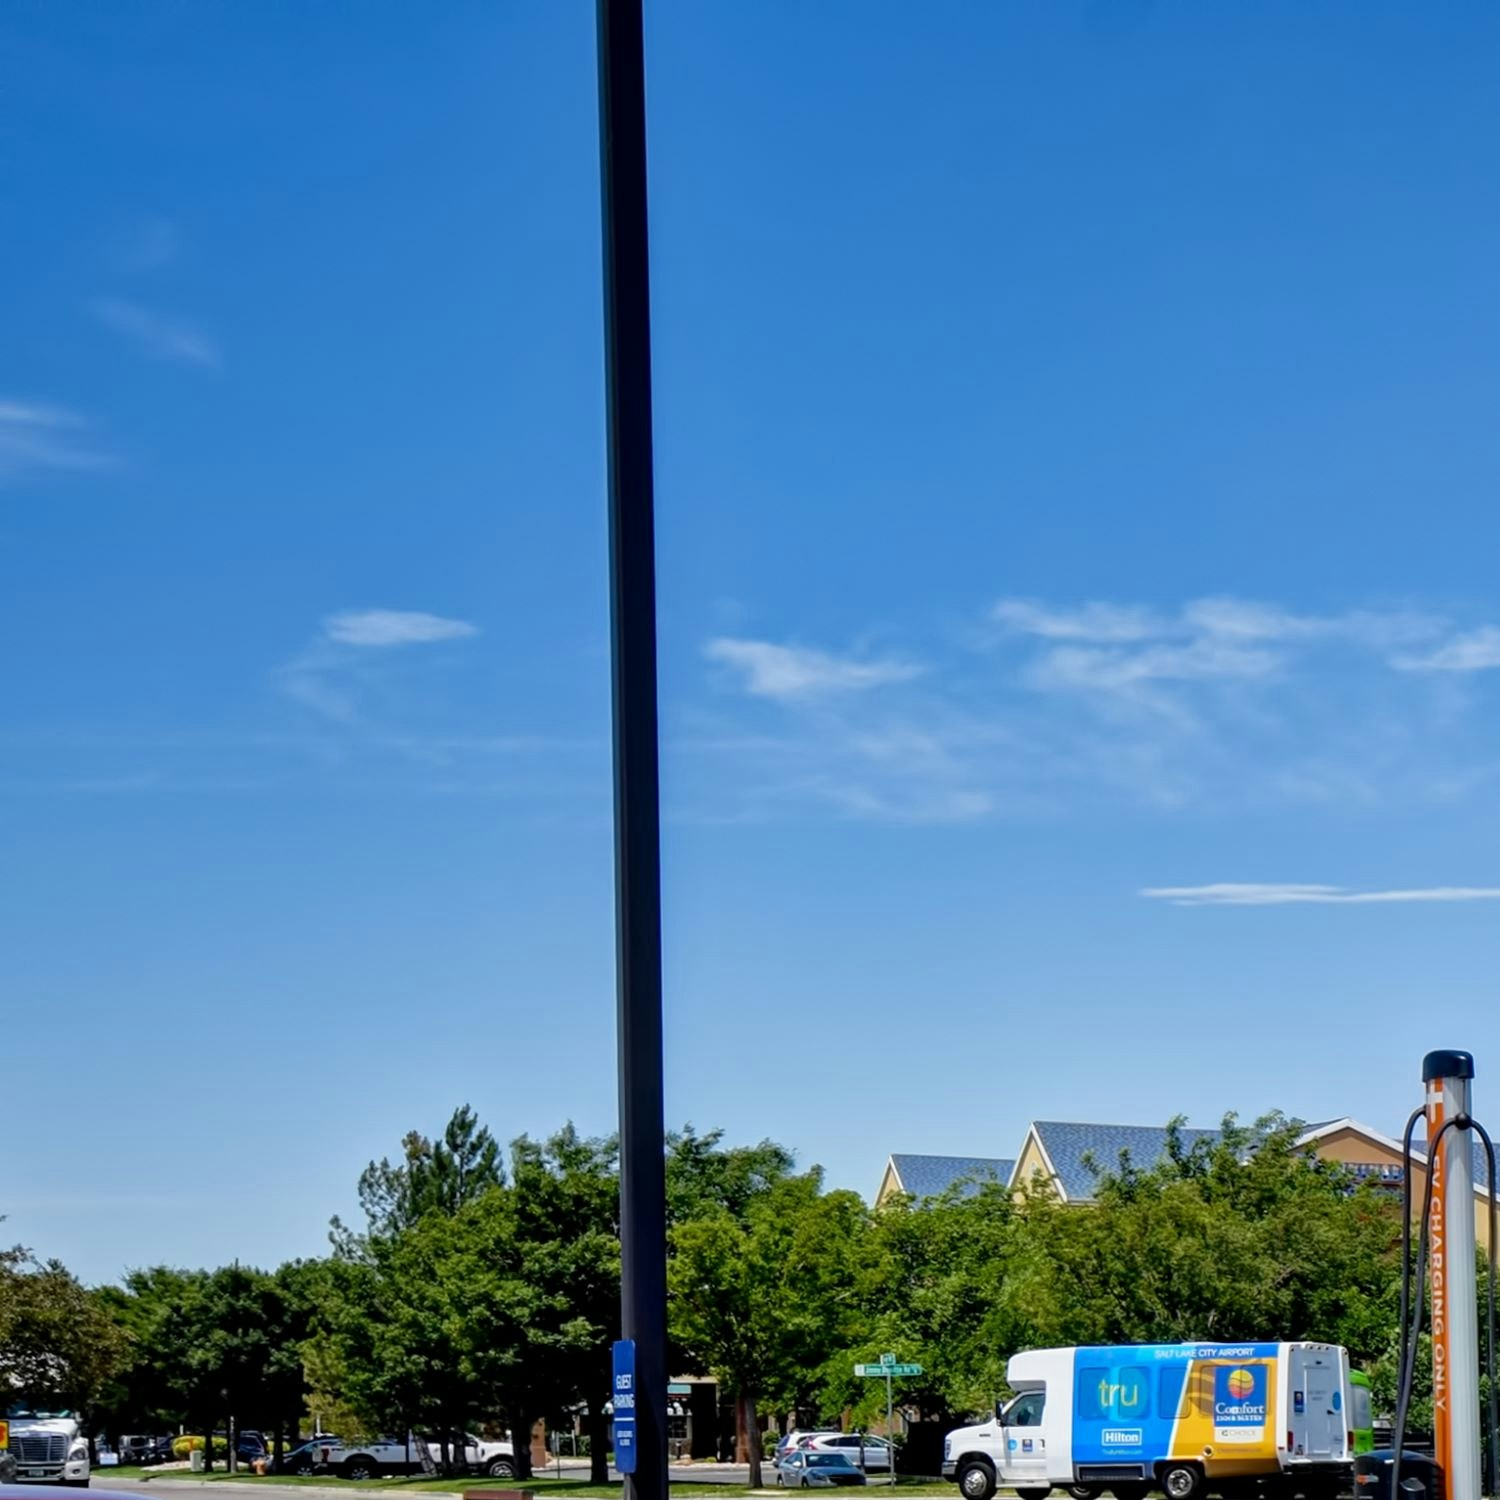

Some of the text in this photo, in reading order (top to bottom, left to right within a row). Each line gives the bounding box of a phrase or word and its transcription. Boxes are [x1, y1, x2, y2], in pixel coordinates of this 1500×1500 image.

[1430, 1196, 1444, 1335] CHARGING
[1198, 1348, 1217, 1358] CITY
[1218, 1347, 1256, 1358] AIRPORT
[1435, 1343, 1446, 1411] ONLY
[1098, 1378, 1138, 1407] tru
[1215, 1401, 1265, 1415] Comfort
[1105, 1432, 1139, 1443] Hilton
